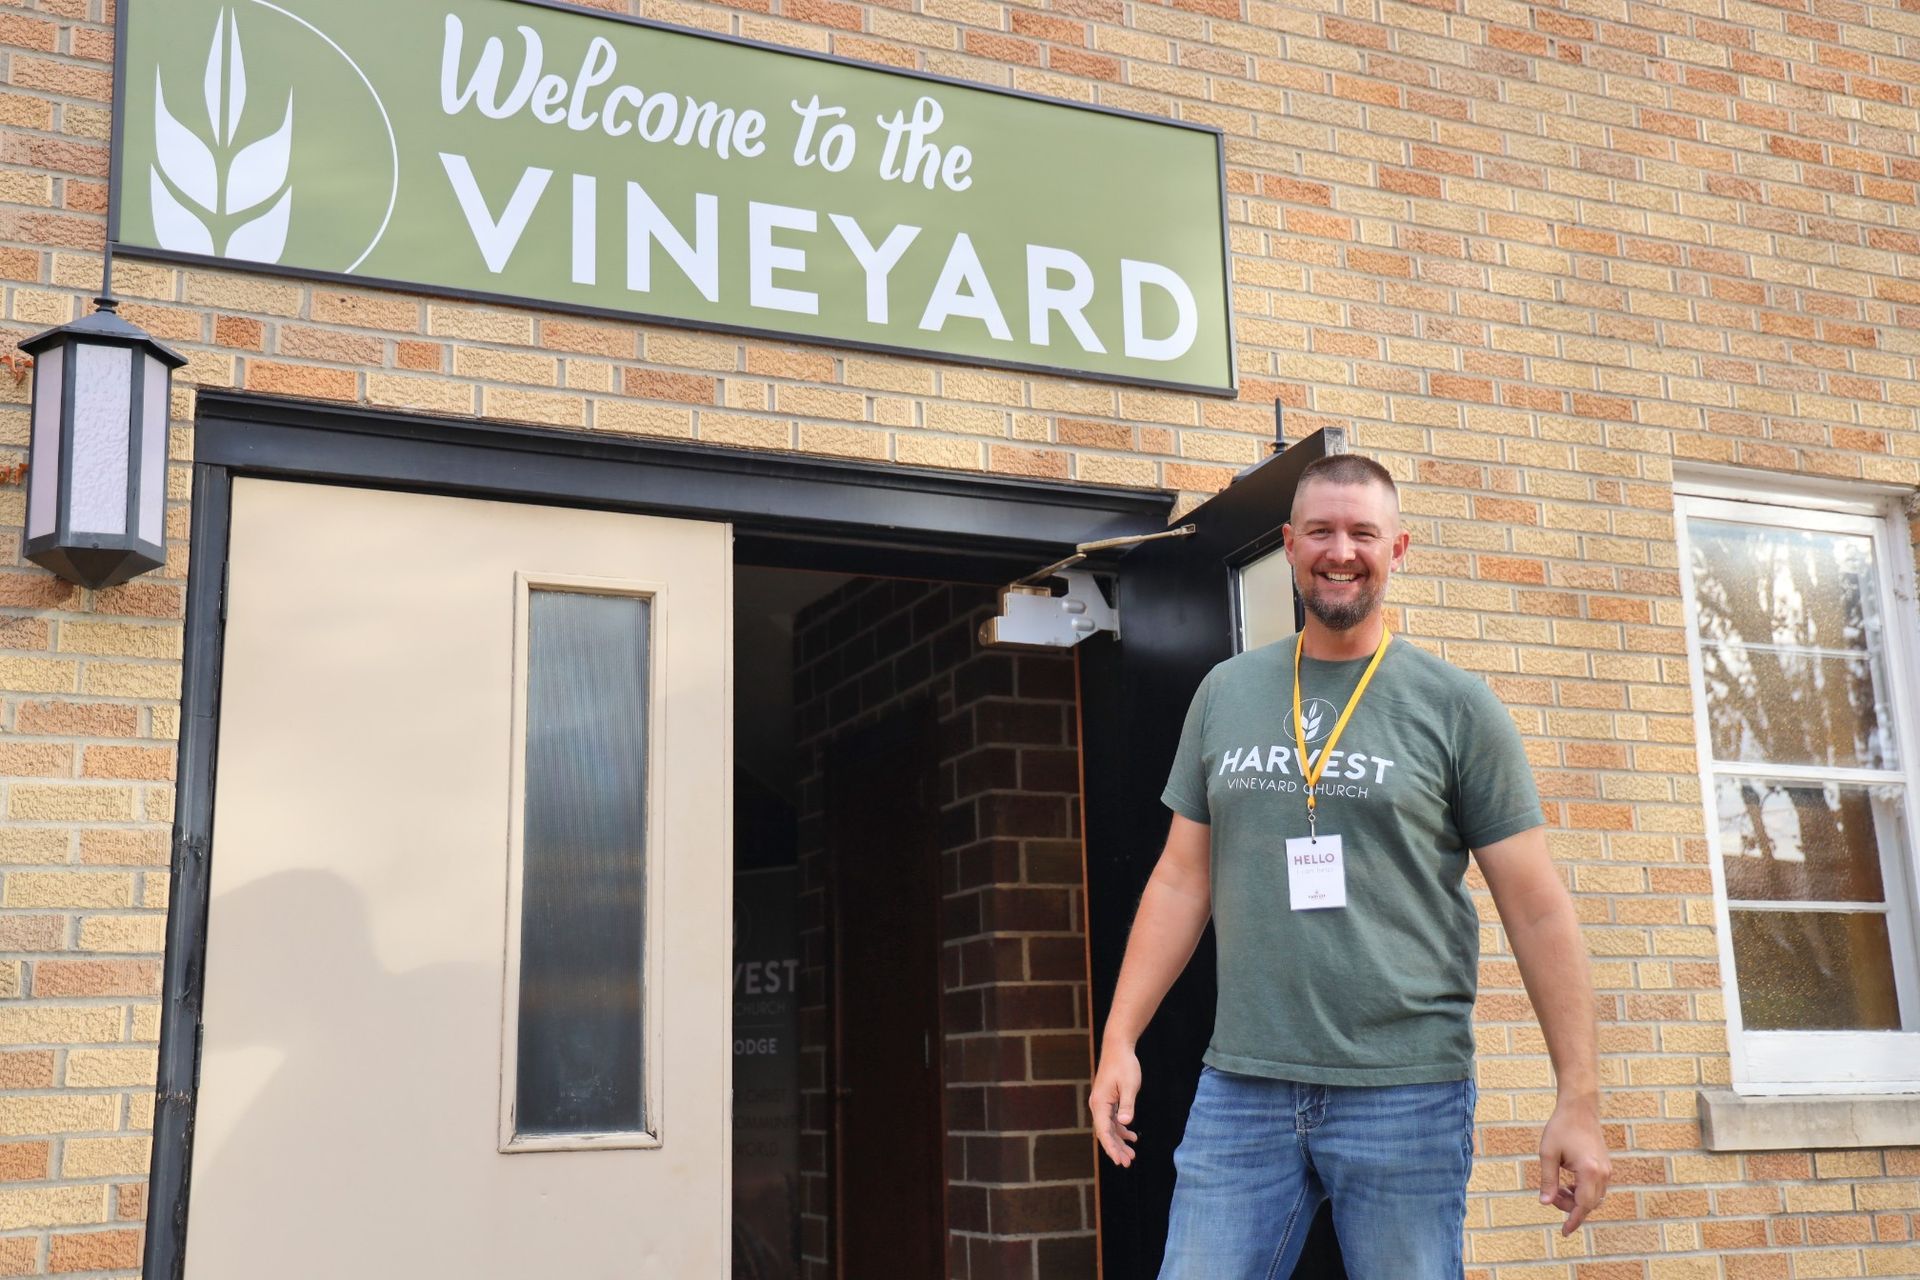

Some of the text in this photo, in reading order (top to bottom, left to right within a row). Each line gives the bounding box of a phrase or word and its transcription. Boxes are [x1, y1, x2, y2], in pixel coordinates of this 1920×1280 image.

[440, 13, 973, 192] Welcome to the
[438, 151, 1199, 362] VINEYARD
[1218, 745, 1395, 784] HARVEST
[1227, 777, 1369, 799] VINEYARD CHURCH
[1294, 853, 1335, 866] HELLO
